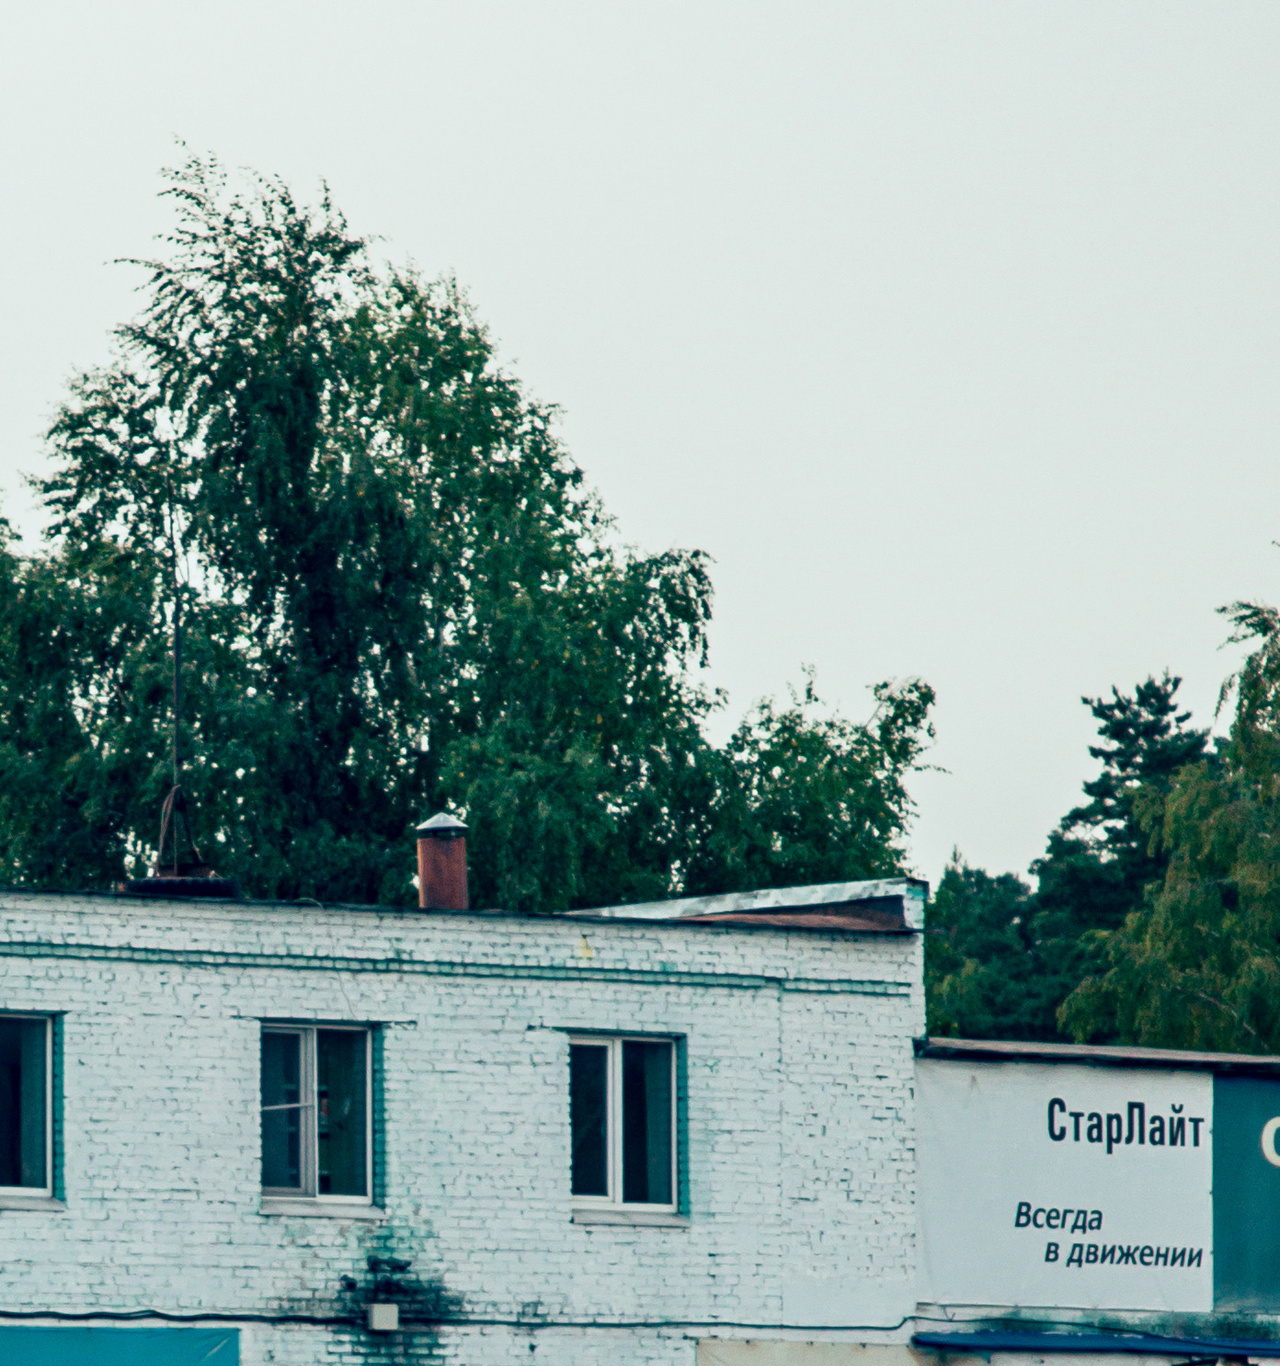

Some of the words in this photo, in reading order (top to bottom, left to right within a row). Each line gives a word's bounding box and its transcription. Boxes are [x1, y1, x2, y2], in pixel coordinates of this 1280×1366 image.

[1047, 1097, 1205, 1155] СтарЛайт
[1014, 1201, 1103, 1234] Всегда
[1044, 1242, 1060, 1263] в
[1066, 1242, 1203, 1268] движении
